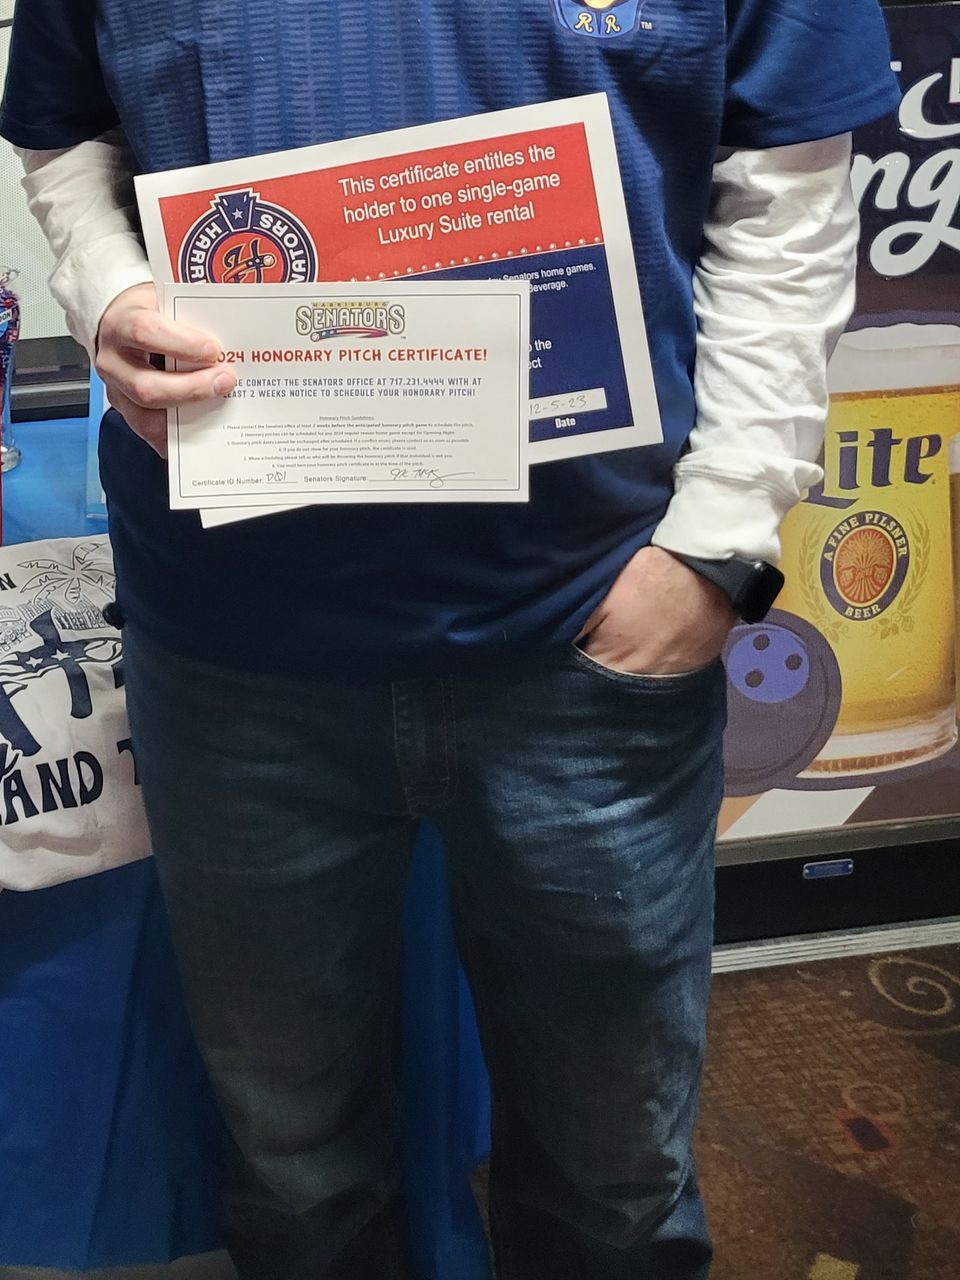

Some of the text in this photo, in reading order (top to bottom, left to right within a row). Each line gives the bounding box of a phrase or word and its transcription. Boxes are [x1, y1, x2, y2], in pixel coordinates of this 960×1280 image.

[338, 144, 557, 197] This certificate entitles the
[343, 173, 561, 225] holder to one single-game
[378, 200, 536, 246] Luxury Suite rental
[503, 270, 540, 281] Senators
[541, 267, 565, 279] home
[566, 261, 597, 277] games.
[296, 303, 406, 336] SENATORS
[534, 339, 552, 351] the
[218, 348, 488, 363] 024 HONORARY PITCH CERTIFICATE!
[246, 378, 281, 387] CONTACT
[285, 378, 299, 387] THE
[302, 377, 343, 386] SENATORS
[347, 377, 374, 386] OFFICE
[377, 377, 387, 386] AT
[389, 377, 445, 387] 717.231.4444
[448, 377, 469, 386] WITH
[472, 377, 482, 386] AT
[250, 390, 256, 398] 2
[259, 389, 286, 398] WEEKS
[289, 389, 318, 398] NOTICE
[321, 389, 331, 397] TO
[334, 389, 375, 398] SCHEDULE
[378, 389, 399, 397] YOUR
[402, 388, 446, 398] HONORARY
[449, 388, 476, 398] PITCH!
[529, 395, 587, 417] 12-5-23
[555, 417, 576, 429] Date
[192, 479, 225, 487] Certificate
[824, 513, 909, 563] A FINE PILSNER
[844, 603, 882, 619] BEER
